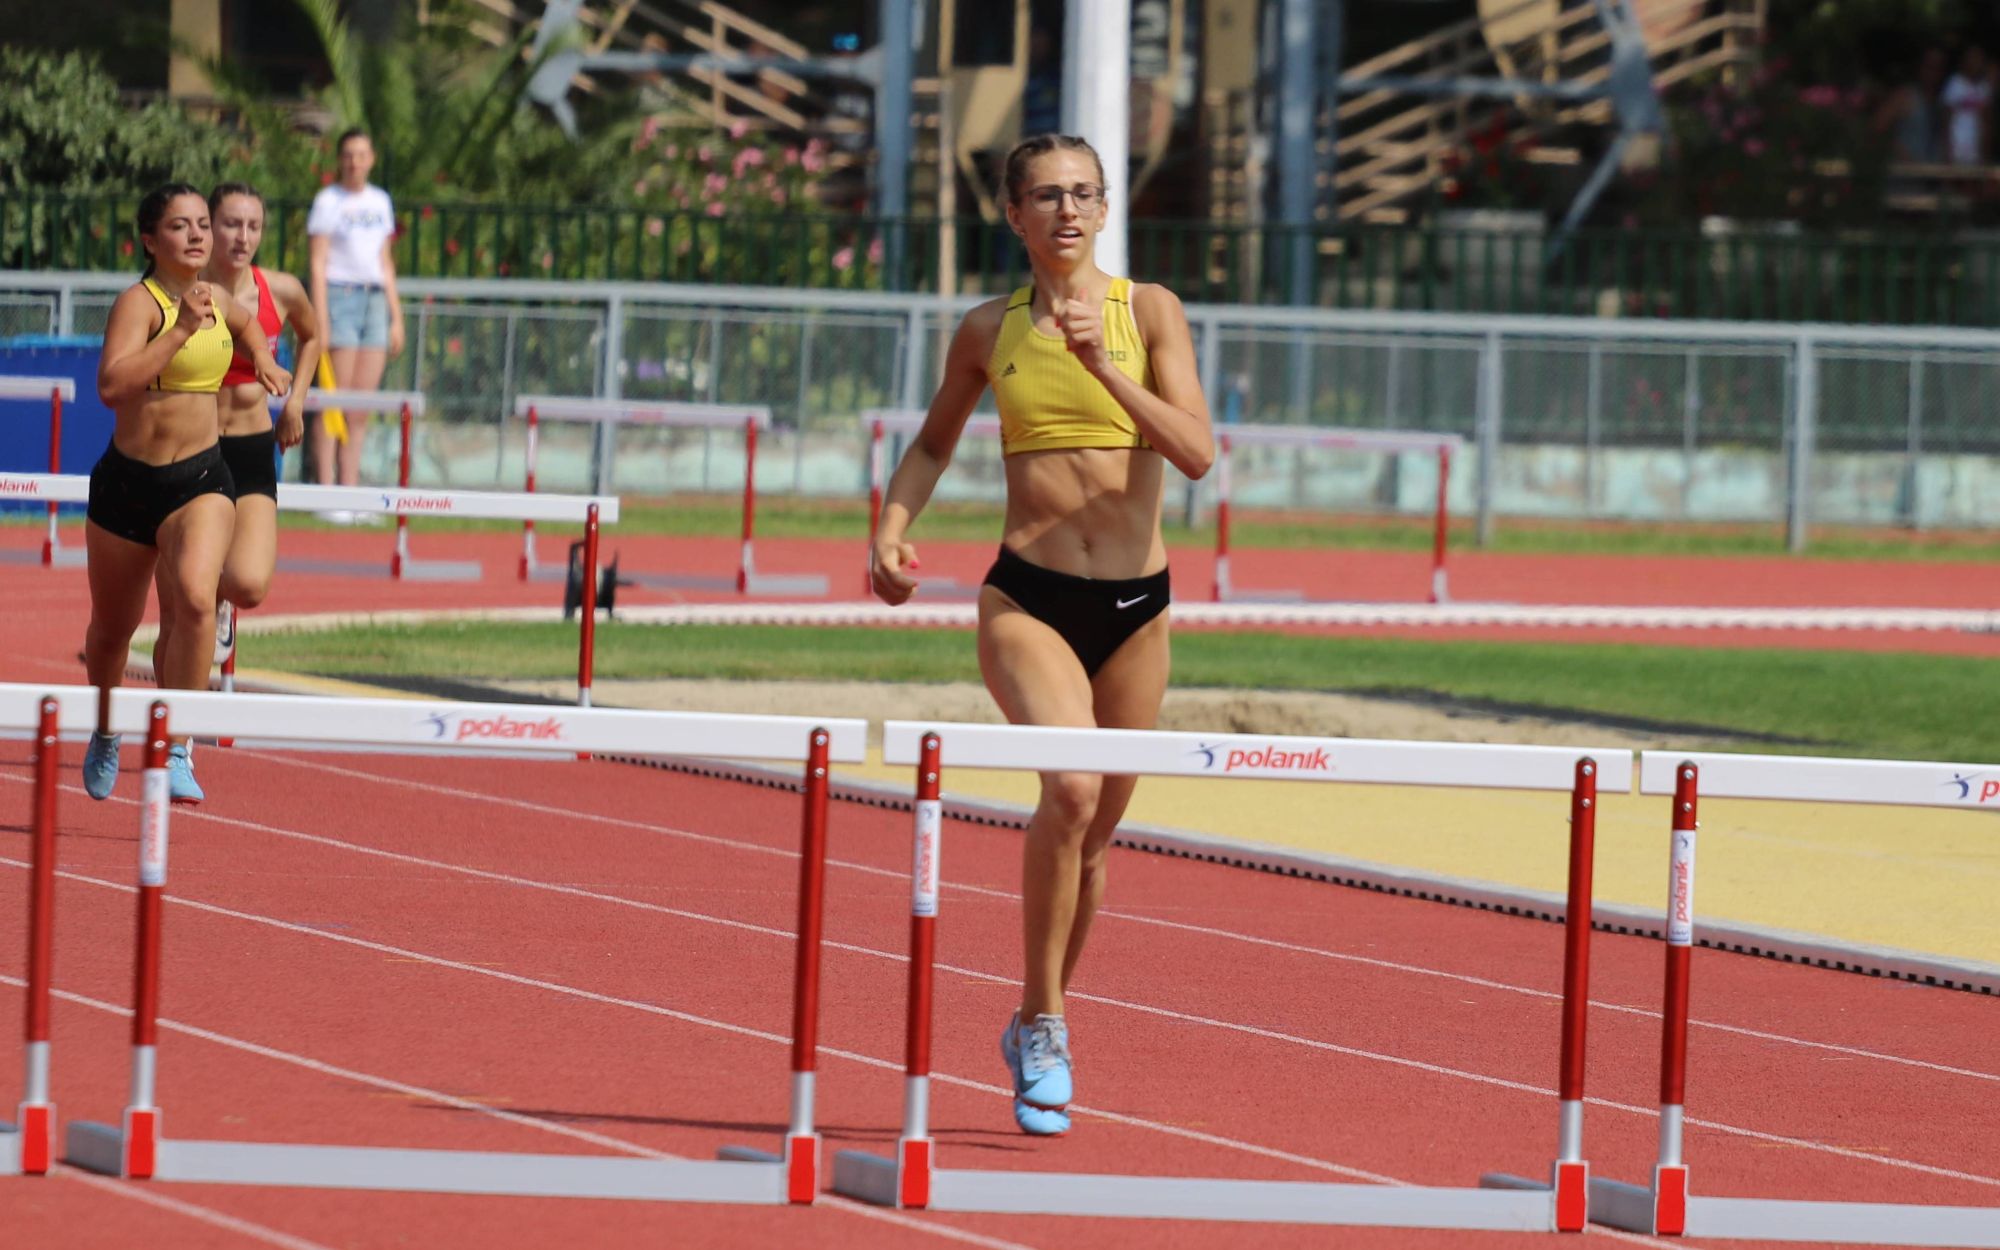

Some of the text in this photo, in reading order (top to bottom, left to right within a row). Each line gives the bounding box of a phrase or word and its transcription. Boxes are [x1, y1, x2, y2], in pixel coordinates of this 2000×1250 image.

[0, 479, 38, 494] lanik
[396, 496, 452, 512] polanik
[457, 714, 561, 740] polanik
[1225, 746, 1330, 771] polanik
[1675, 861, 1688, 923] polanik
